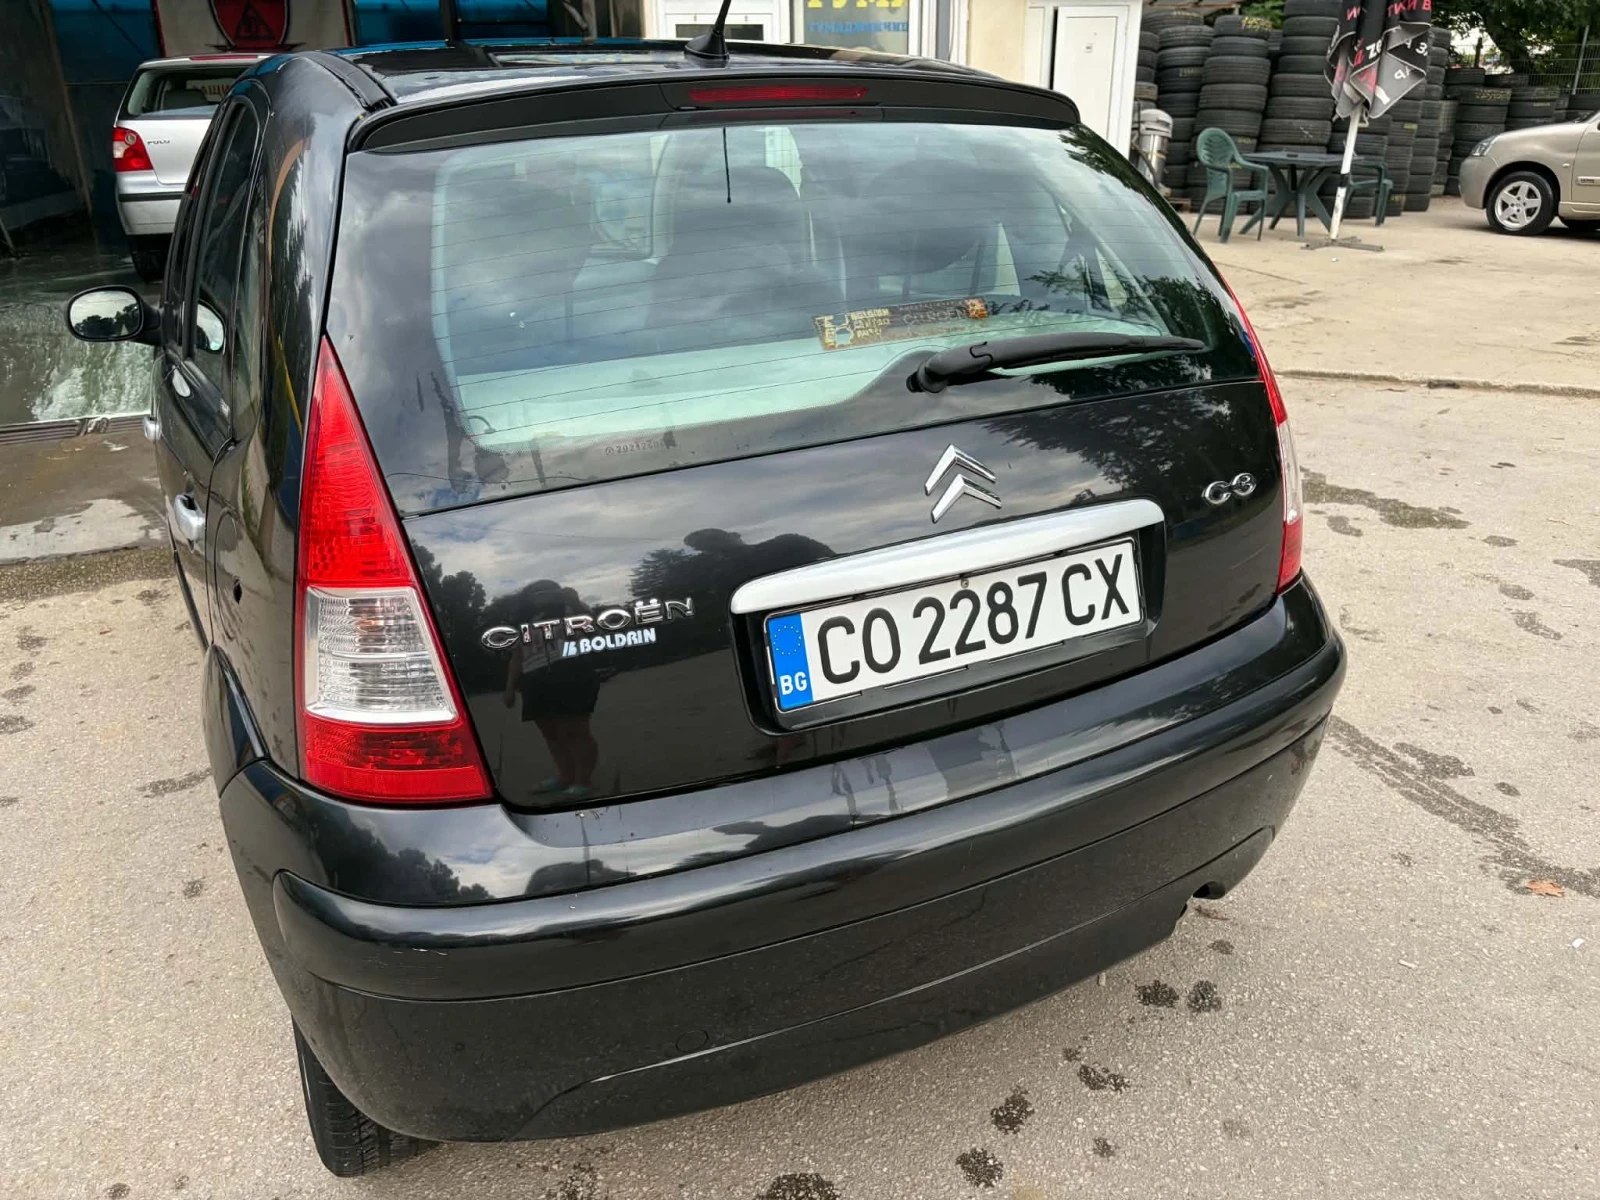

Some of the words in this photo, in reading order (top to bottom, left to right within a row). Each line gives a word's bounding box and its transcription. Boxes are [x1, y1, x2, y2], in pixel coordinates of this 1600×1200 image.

[1201, 472, 1257, 505] C3
[481, 598, 695, 649] CITROËN
[817, 607, 901, 684] CO
[912, 571, 1048, 665] 2287
[1061, 553, 1130, 626] CX
[579, 627, 656, 653] BOLDRIN
[779, 671, 807, 696] BG
